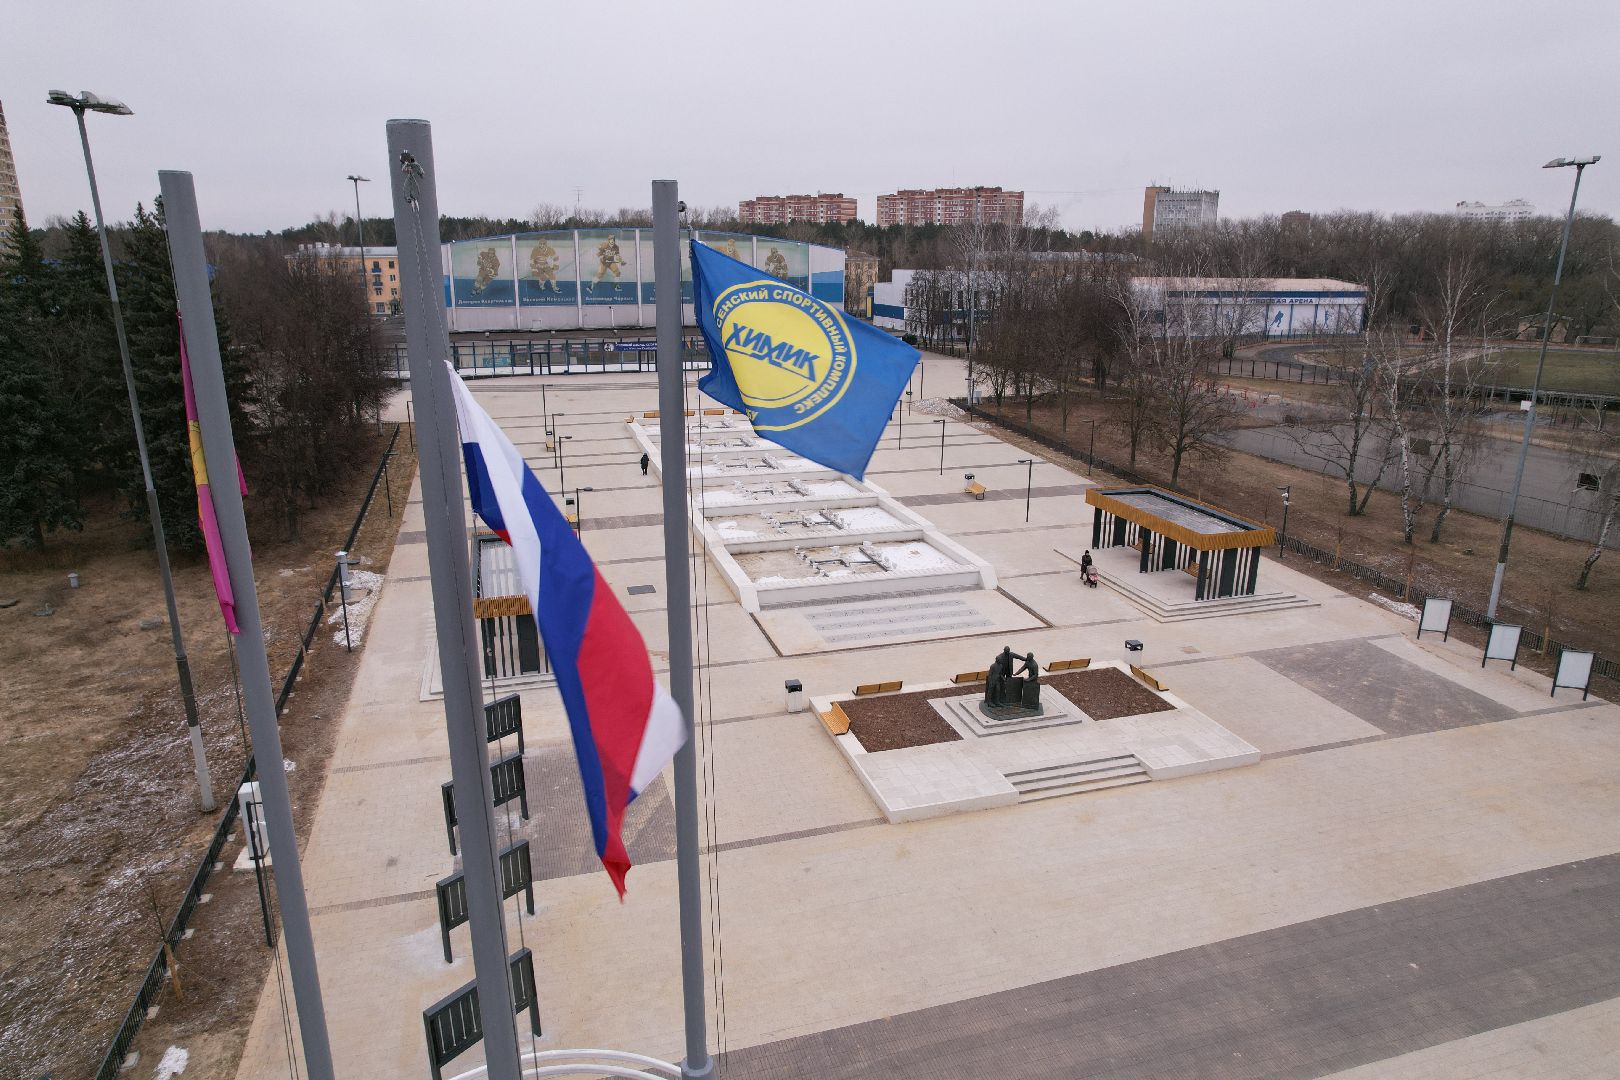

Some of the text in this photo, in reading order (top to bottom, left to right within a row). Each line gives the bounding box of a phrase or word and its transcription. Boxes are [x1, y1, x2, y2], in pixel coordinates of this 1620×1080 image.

[773, 289, 848, 353] СПОРТИВНЫЙ
[725, 323, 821, 382] ХИМИК
[794, 355, 848, 414] КОМПЛЕКС
